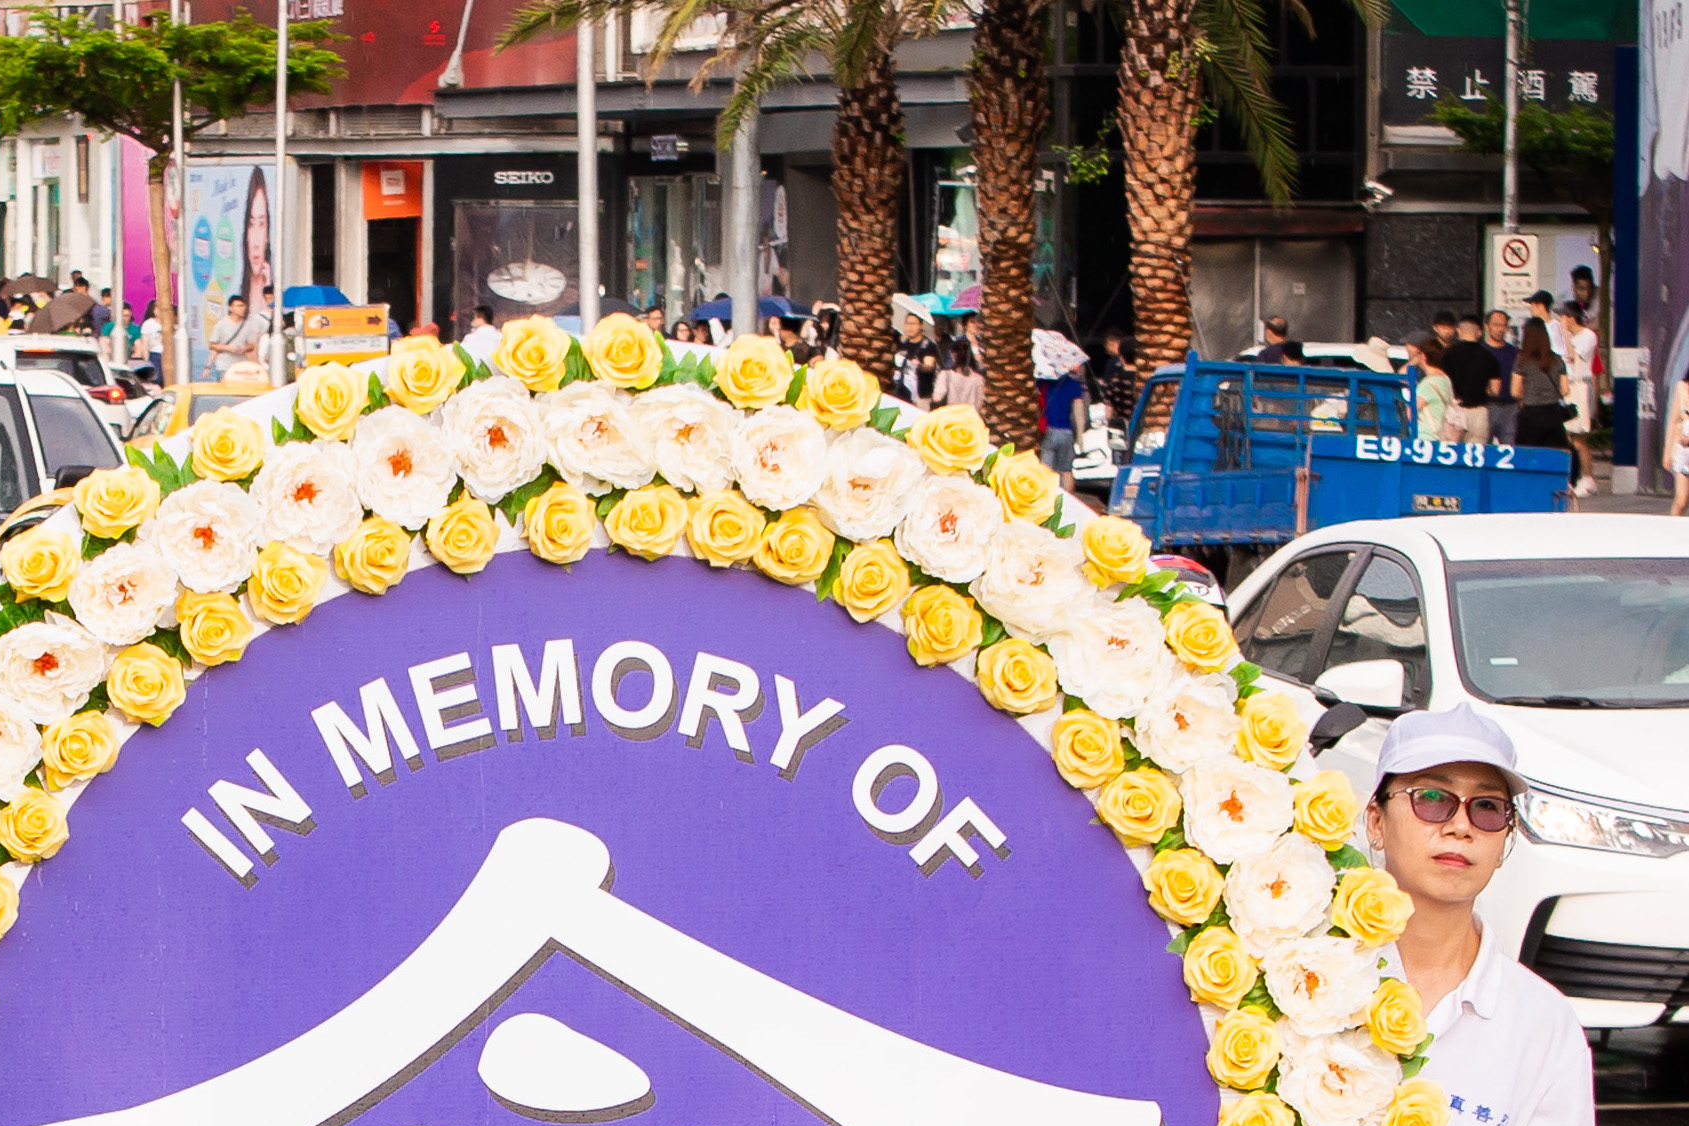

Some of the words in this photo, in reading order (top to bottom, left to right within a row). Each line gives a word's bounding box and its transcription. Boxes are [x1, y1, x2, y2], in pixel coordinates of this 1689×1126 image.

[494, 171, 554, 185] SEIKO
[181, 748, 313, 880] IN
[312, 639, 845, 790] MEMORY
[852, 745, 1007, 870] OF
